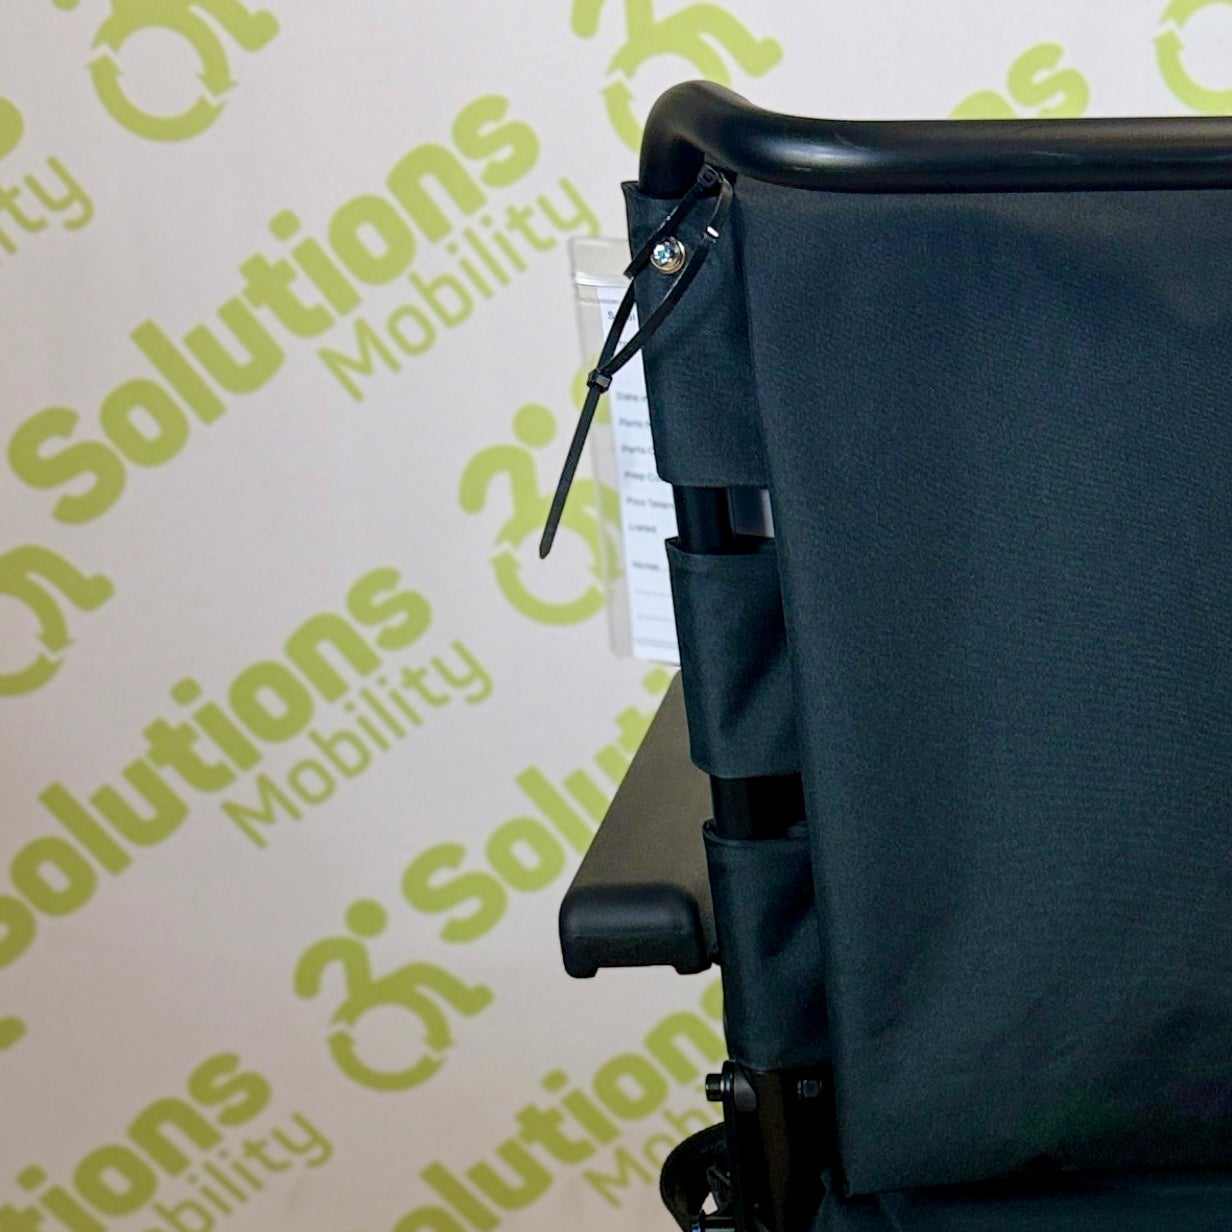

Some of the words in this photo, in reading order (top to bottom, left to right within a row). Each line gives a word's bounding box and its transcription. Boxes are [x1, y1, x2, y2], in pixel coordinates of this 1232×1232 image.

[7, 94, 541, 526] Solutions
[316, 177, 601, 403] Mobility
[221, 640, 494, 849] Mobility
